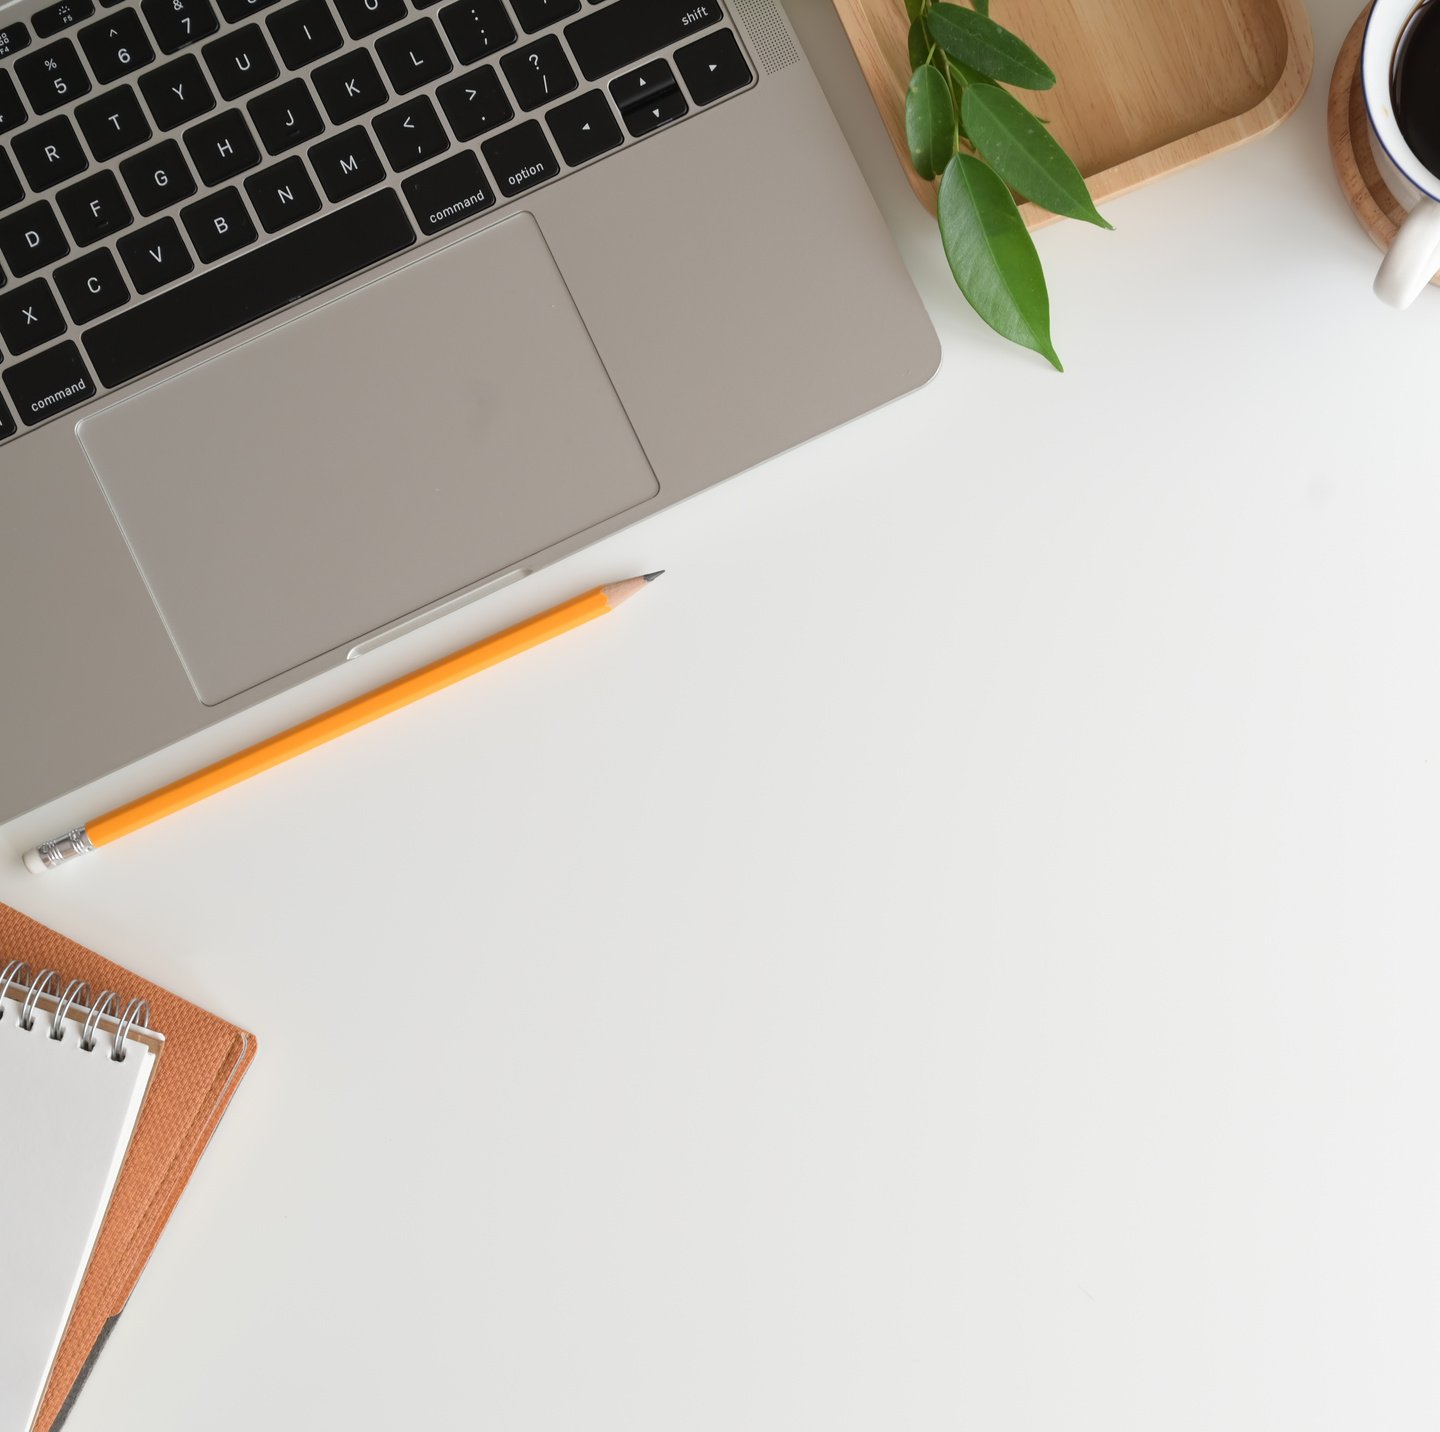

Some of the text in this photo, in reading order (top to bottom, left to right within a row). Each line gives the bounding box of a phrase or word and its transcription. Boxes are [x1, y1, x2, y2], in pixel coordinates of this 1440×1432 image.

[62, 14, 73, 24] F5
[681, 6, 710, 26] shift
[181, 17, 191, 34] 7
[303, 24, 312, 40] I
[0, 46, 10, 55] F4
[117, 48, 131, 64] 6
[409, 51, 424, 66] L
[44, 58, 58, 71] %
[235, 53, 251, 71] U
[528, 53, 540, 71] ?
[53, 77, 68, 94] 5
[171, 83, 184, 101] Y
[344, 78, 361, 97] K
[542, 74, 549, 94] /
[464, 88, 477, 101] >
[107, 113, 121, 131] T
[285, 109, 295, 127] J
[403, 116, 415, 129] <
[44, 145, 60, 163] R
[216, 138, 234, 158] H
[339, 154, 359, 175] M
[154, 169, 169, 187] G
[508, 162, 544, 186] option
[277, 185, 294, 204] N
[89, 199, 101, 218] F
[429, 189, 485, 224] command
[213, 216, 229, 234] B
[24, 230, 40, 248] D
[148, 245, 162, 263] V
[87, 276, 101, 294] C
[21, 306, 38, 325] X
[31, 378, 86, 412] command
